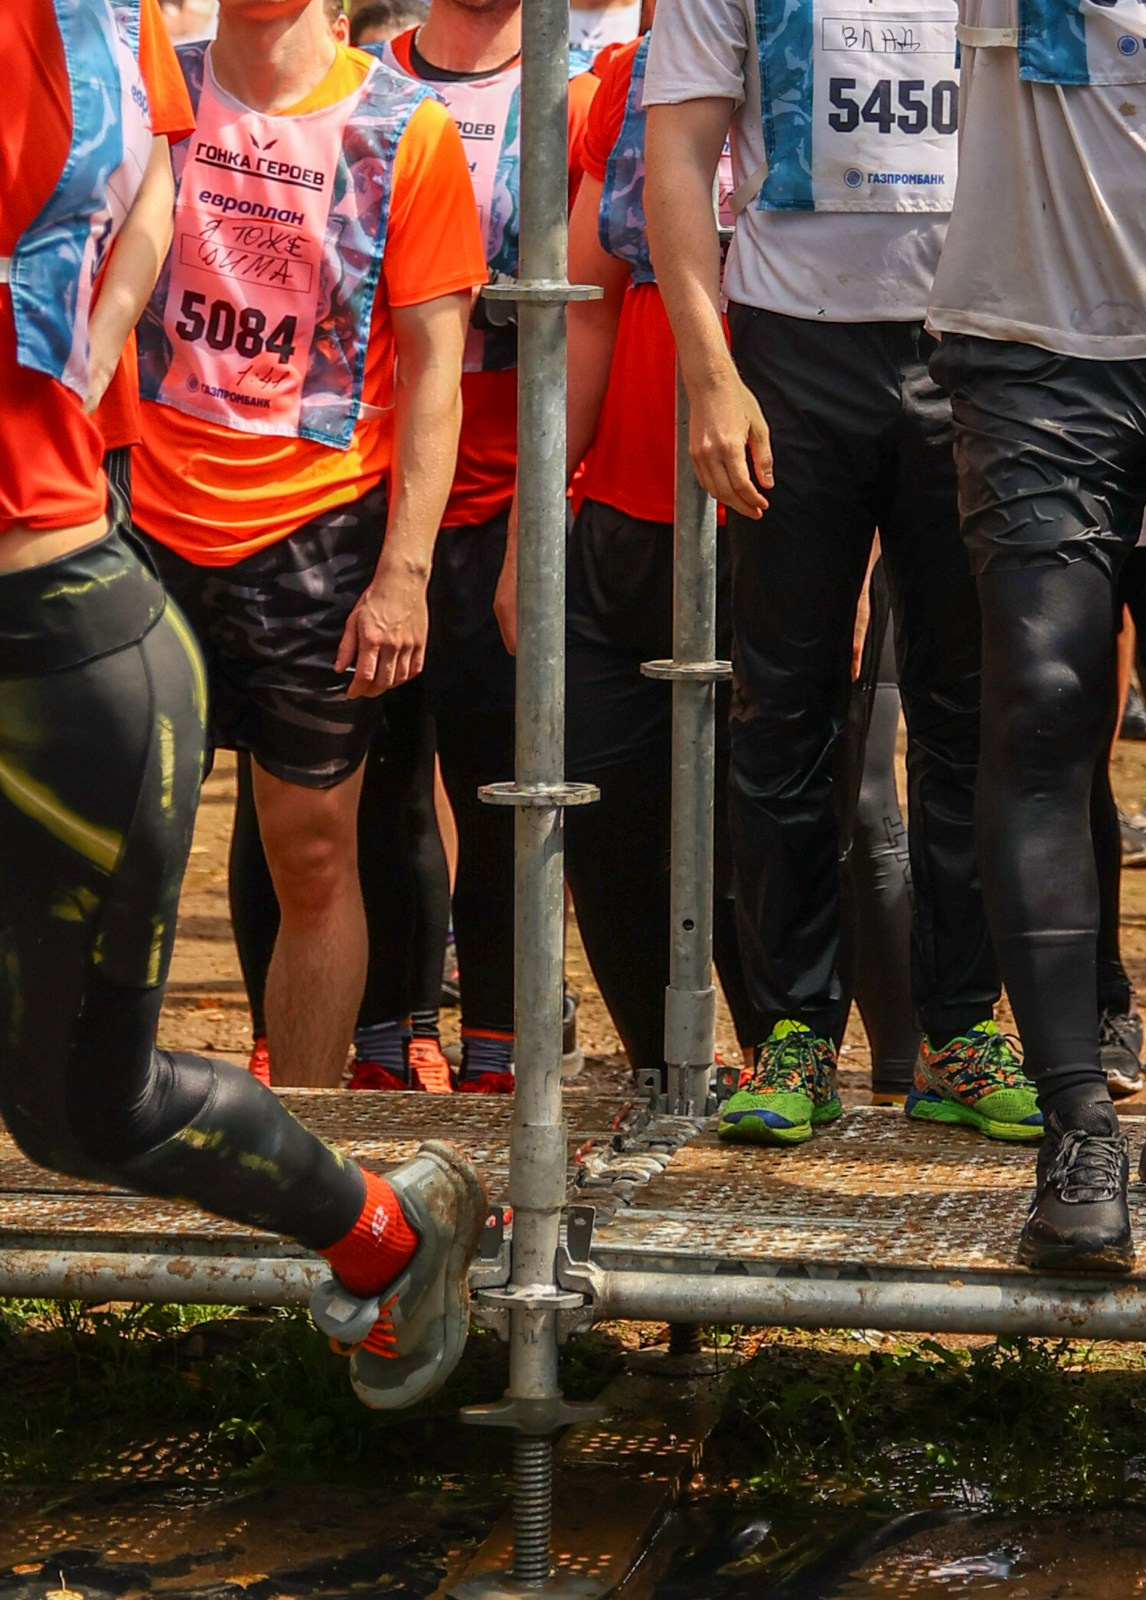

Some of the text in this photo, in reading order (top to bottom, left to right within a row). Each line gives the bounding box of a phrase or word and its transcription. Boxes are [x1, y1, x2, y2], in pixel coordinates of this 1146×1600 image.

[828, 77, 960, 135] 5450
[195, 142, 325, 186] ГОНКА ГЕРОЕВ
[867, 172, 945, 185] ГАЗПРОМБАНК
[199, 190, 305, 226] европлан
[175, 289, 298, 365] 5084
[201, 383, 271, 409] ГАЗПРОМБАНК
